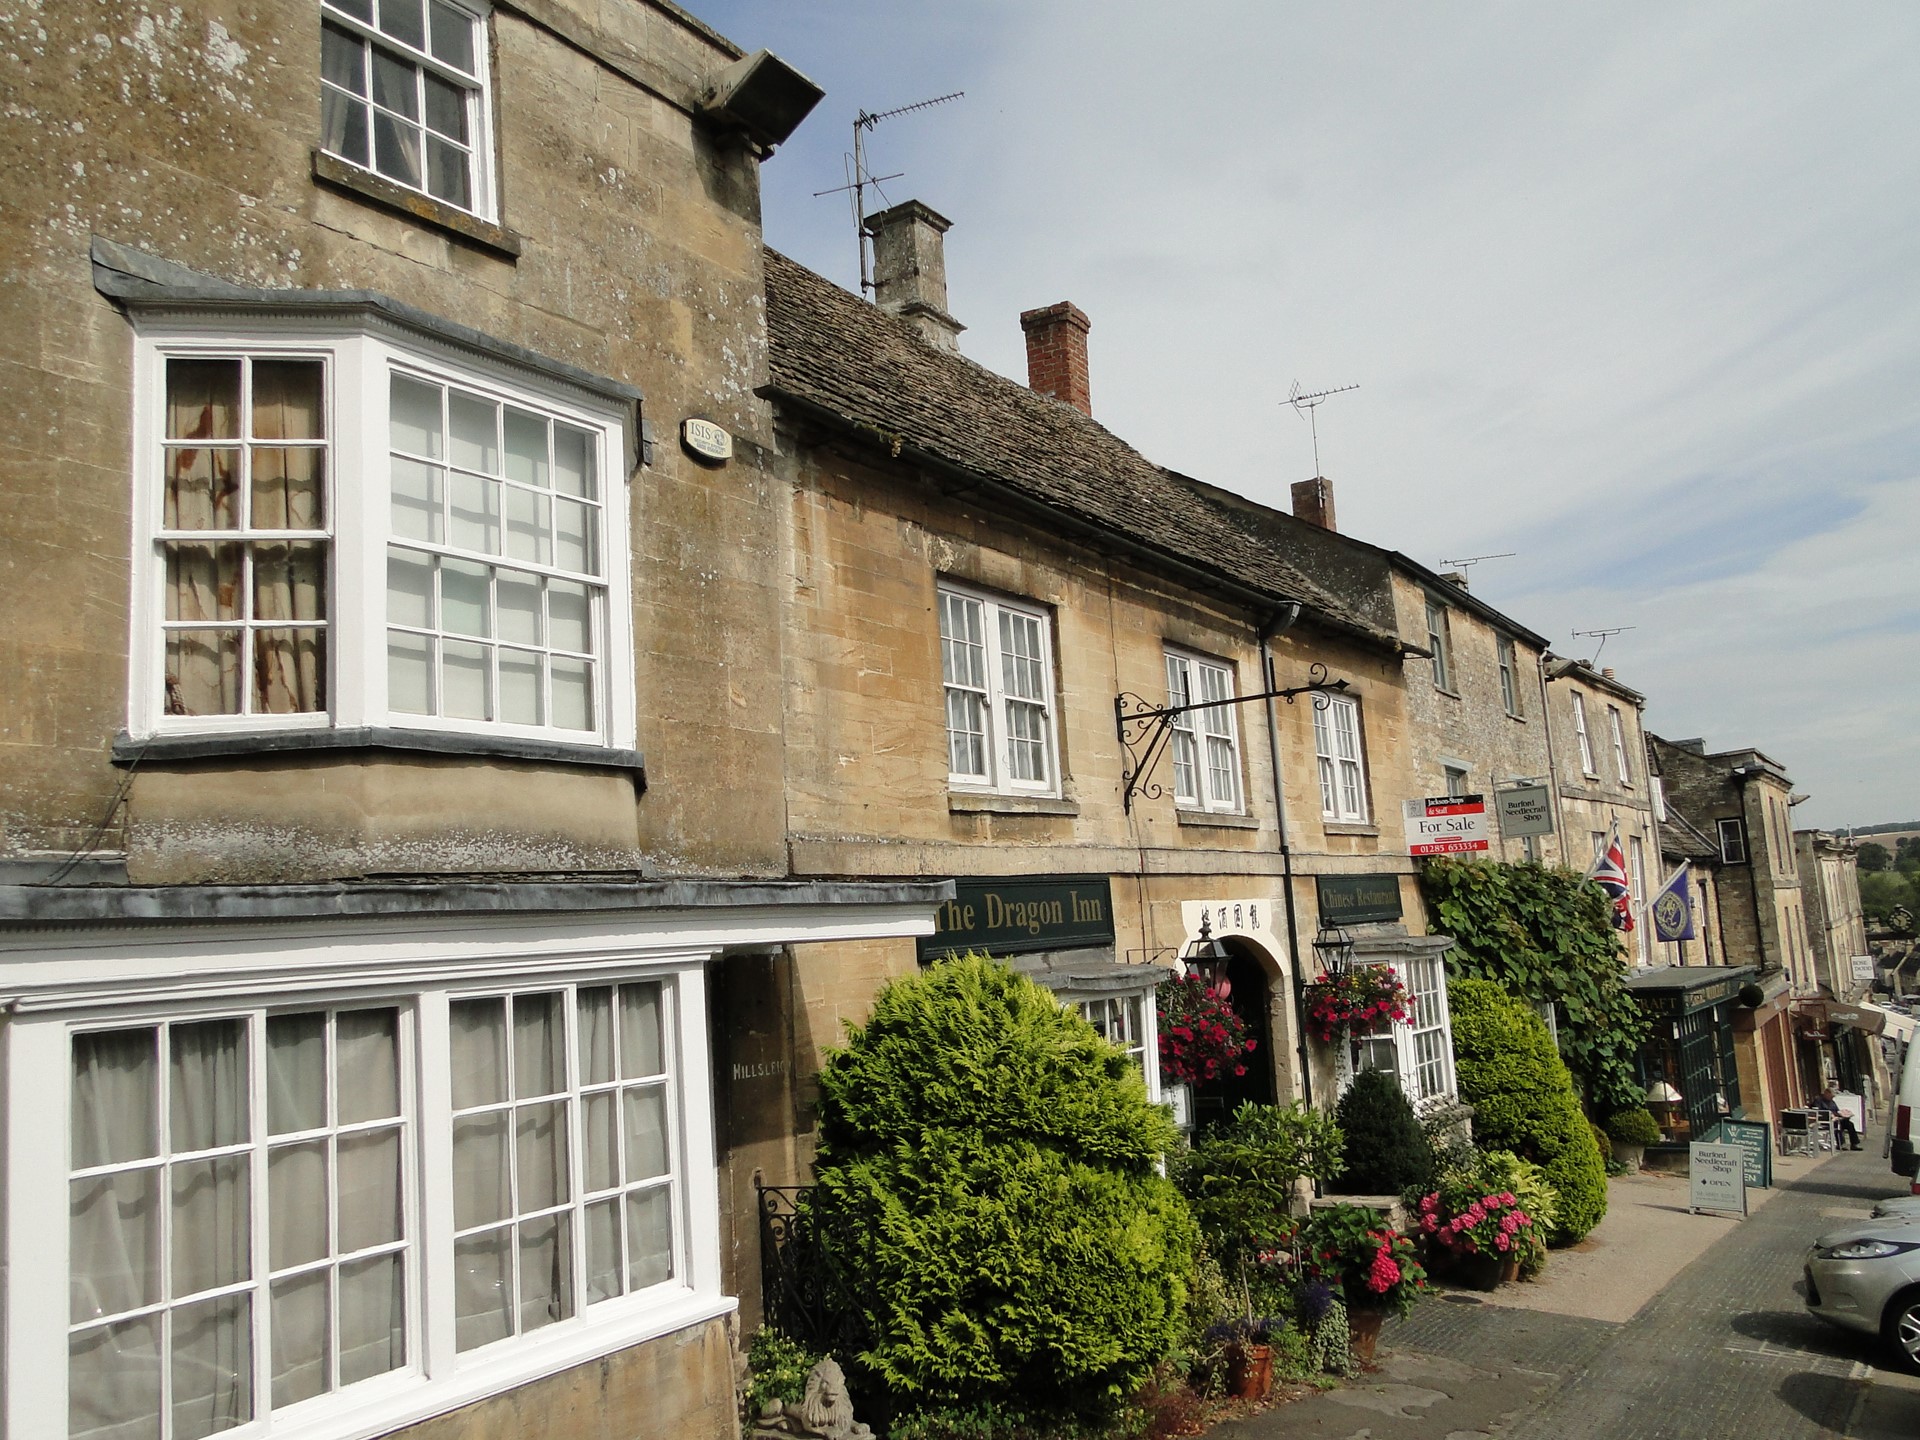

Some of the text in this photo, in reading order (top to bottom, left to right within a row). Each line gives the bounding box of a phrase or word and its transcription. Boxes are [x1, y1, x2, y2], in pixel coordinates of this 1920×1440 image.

[691, 422, 711, 440] ISIS
[1507, 799, 1535, 808] Burford
[1505, 806, 1546, 816] Needlecraft
[1523, 814, 1542, 822] Shop
[1419, 816, 1475, 833] For Sale
[1420, 842, 1478, 853] 01285 653334
[1322, 888, 1354, 908] Chinese
[984, 892, 1064, 935] Dragon
[1069, 890, 1103, 923] Inn
[1694, 1156, 1737, 1167] Needlecraft
[1712, 1165, 1732, 1174] Shop
